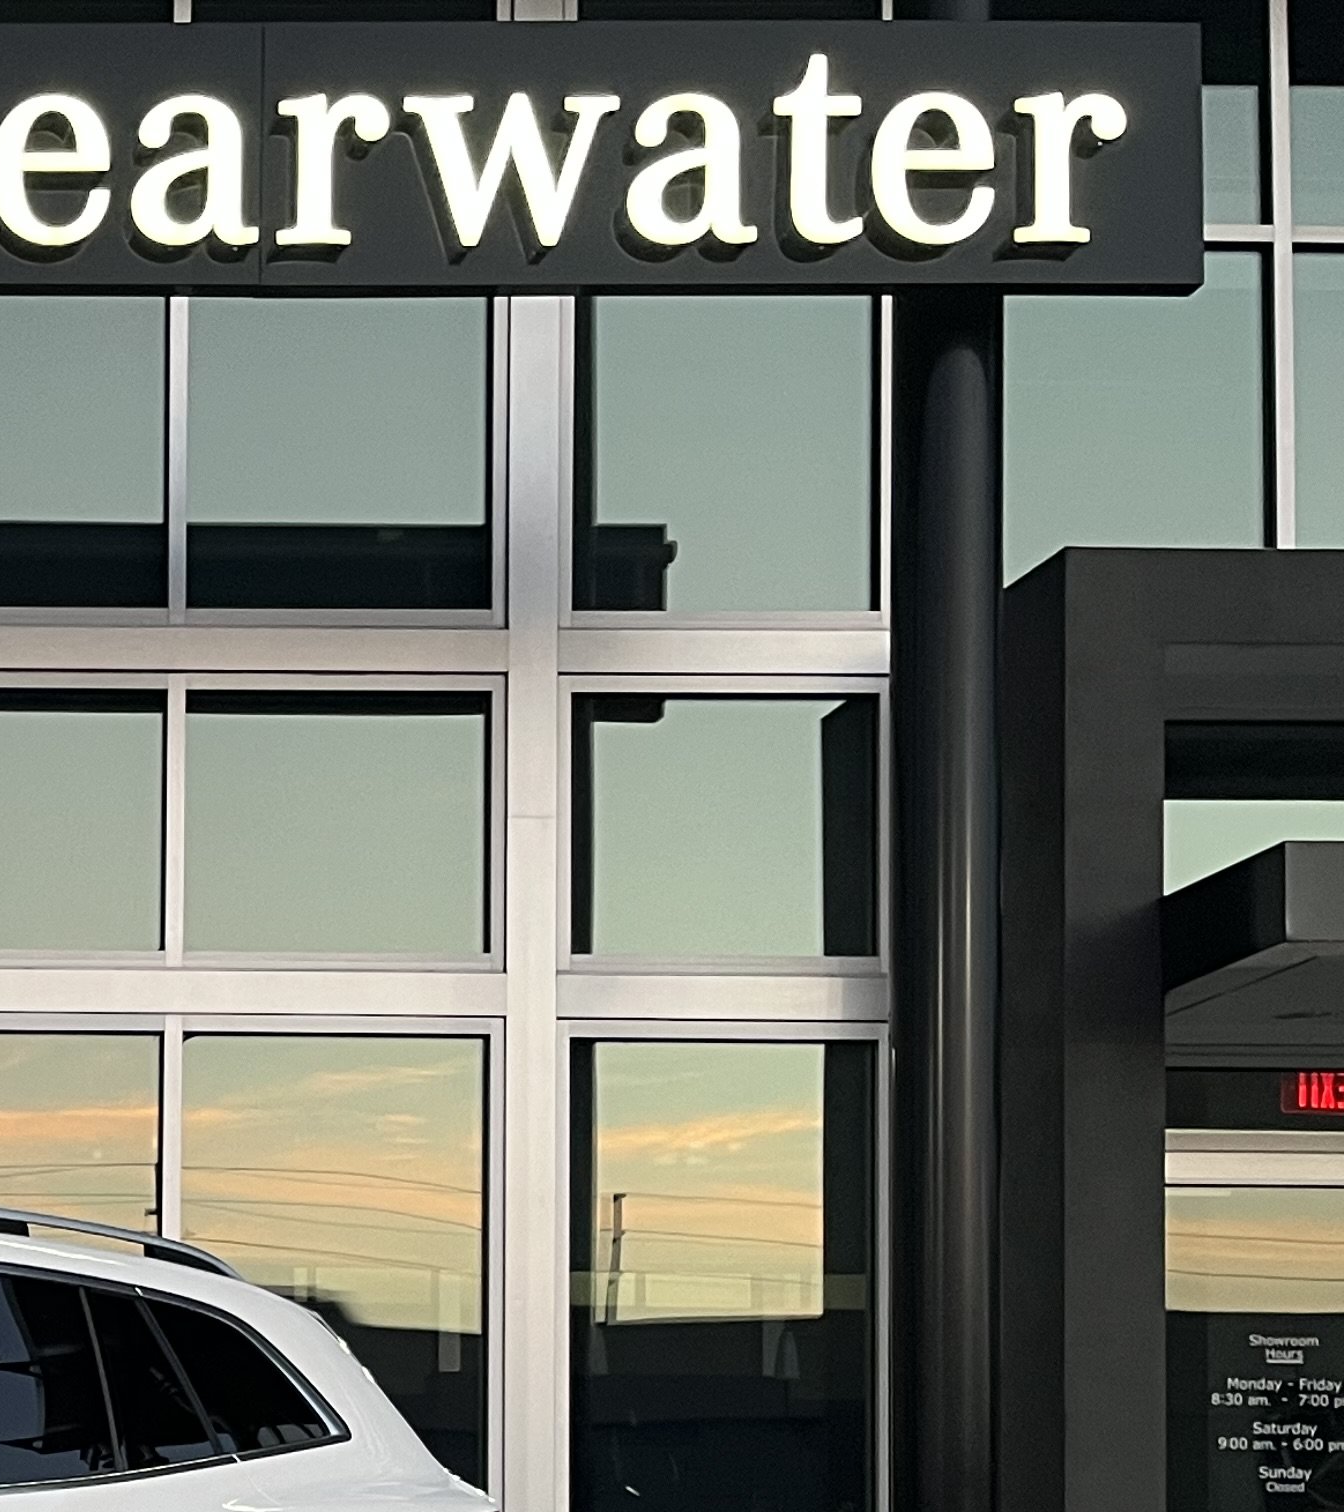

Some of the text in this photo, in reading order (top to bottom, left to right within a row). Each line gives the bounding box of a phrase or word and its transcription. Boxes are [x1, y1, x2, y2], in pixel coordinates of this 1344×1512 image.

[1248, 1333, 1320, 1347] Showroom
[1265, 1347, 1304, 1361] Hours
[1226, 1377, 1283, 1394] Monday
[1298, 1377, 1342, 1394] Friday
[1210, 1392, 1243, 1407] 8:30
[1298, 1393, 1330, 1407] 7:00
[1252, 1421, 1318, 1438] Saturday
[1258, 1465, 1312, 1482] Sunday
[1265, 1481, 1306, 1493] Closed
